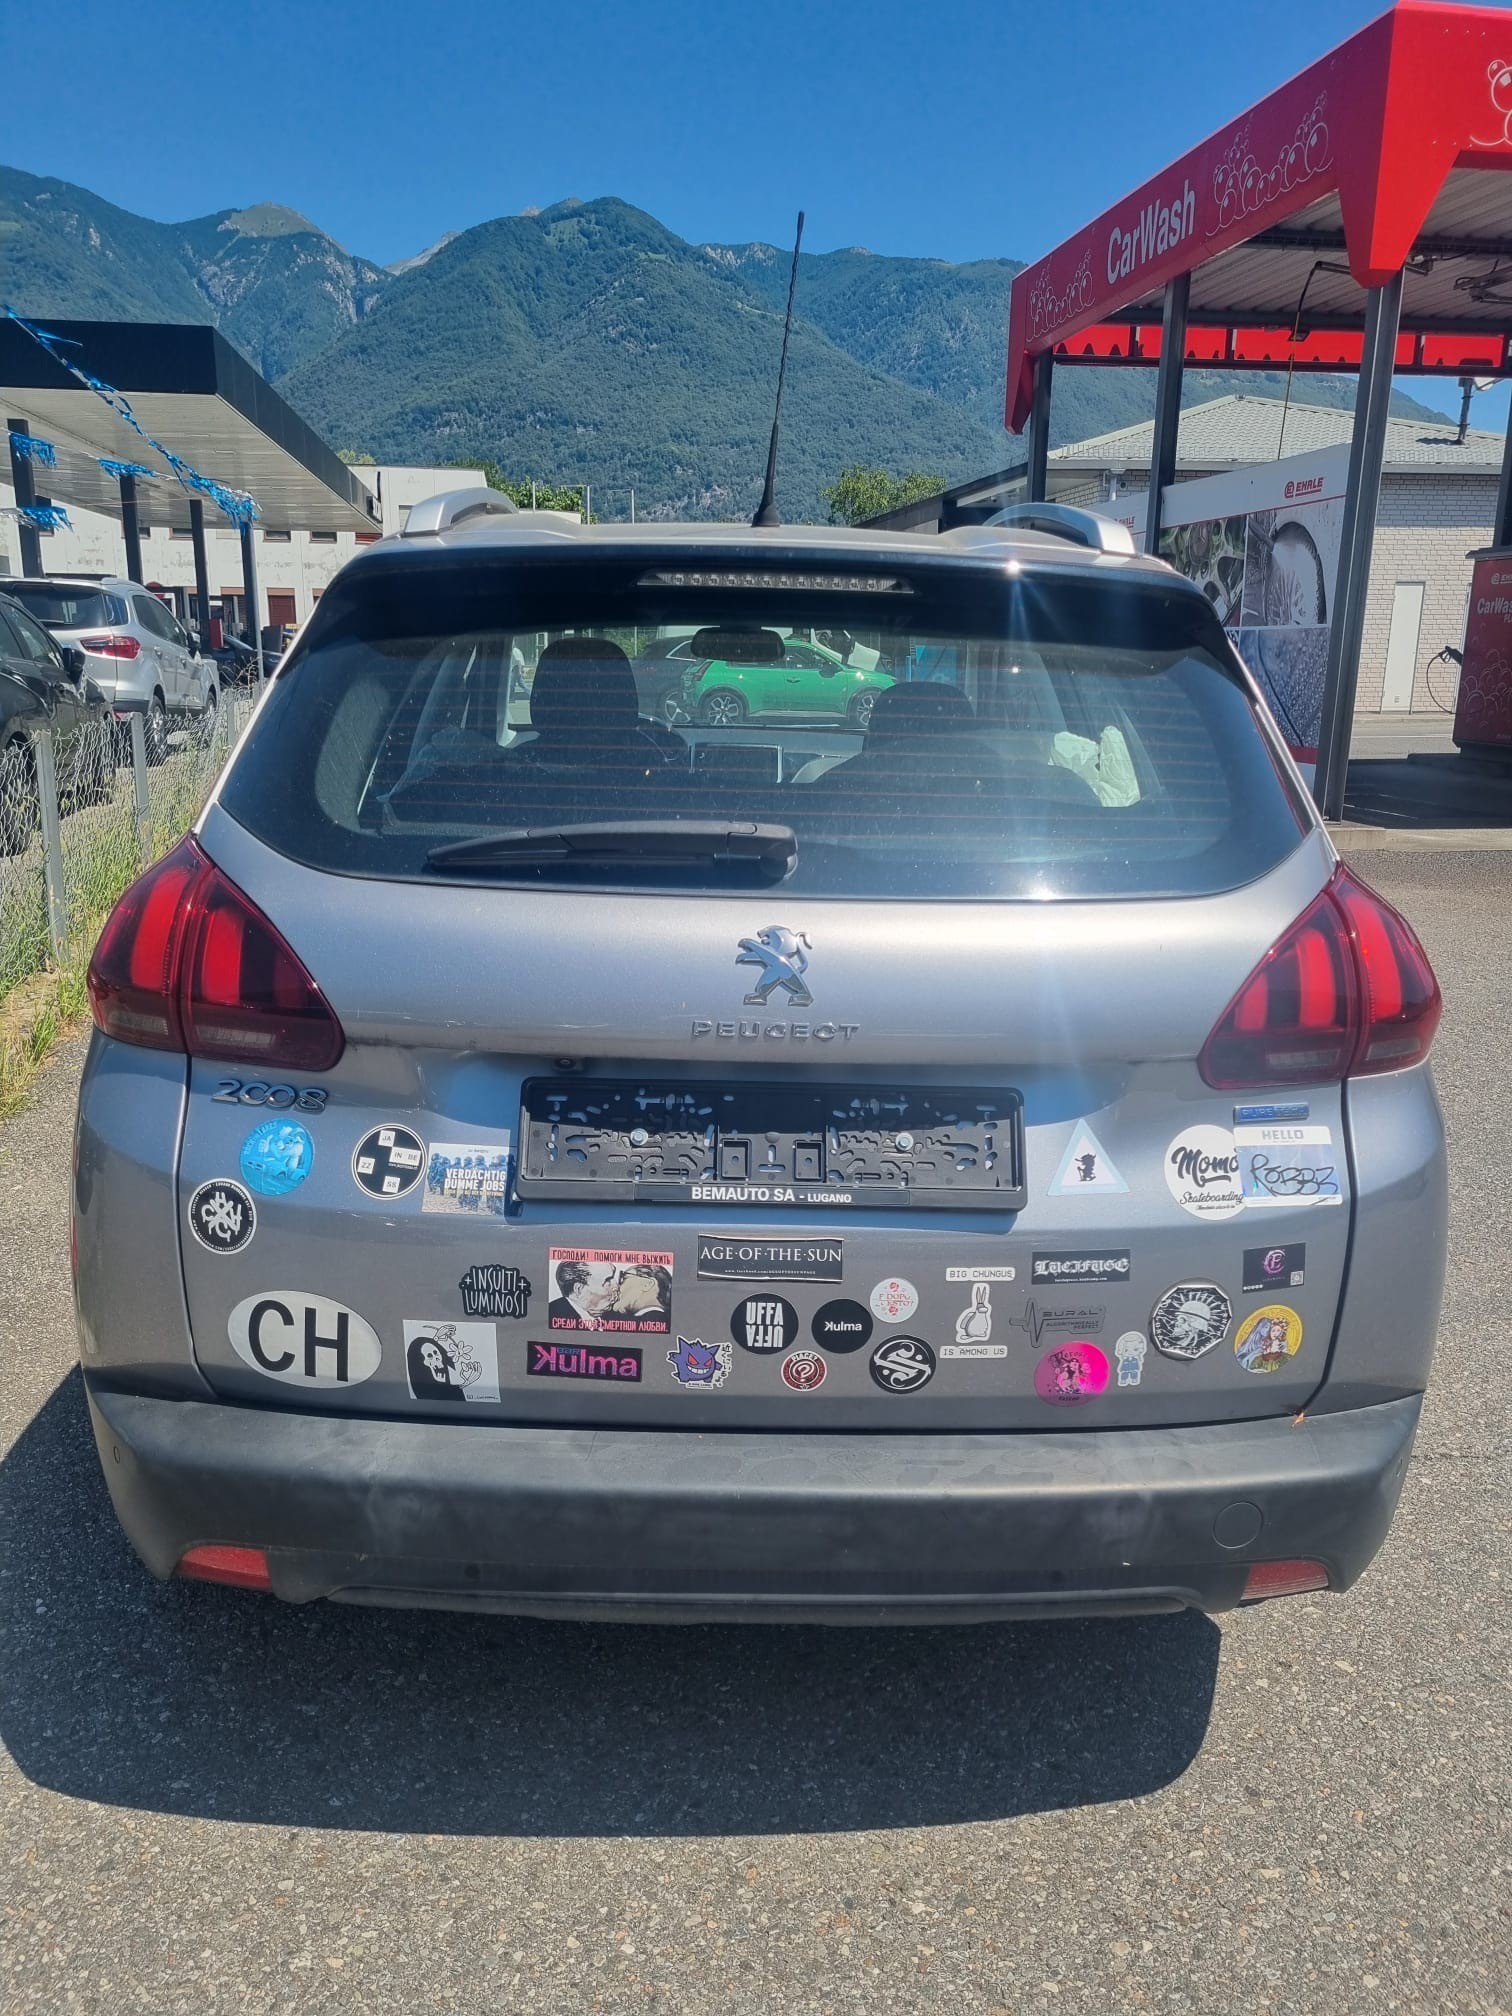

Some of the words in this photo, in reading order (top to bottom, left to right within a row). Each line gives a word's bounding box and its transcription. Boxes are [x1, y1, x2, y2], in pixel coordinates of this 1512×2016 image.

[1107, 179, 1195, 284] CarWash
[1295, 477, 1324, 492] EHRLE
[692, 1020, 860, 1039] PEUGEOT
[212, 1079, 328, 1114] 2008
[1262, 1129, 1304, 1140] HELLO
[444, 1178, 478, 1190] DUMME
[480, 1180, 505, 1191] JOBS
[691, 1187, 769, 1200] BEMAUTO
[773, 1188, 795, 1201] SA
[807, 1193, 852, 1203] LUGANO
[1180, 1191, 1245, 1206] Skateboarding
[552, 1250, 589, 1260] ГОСПОДИ!
[594, 1252, 622, 1262] ПОМОГИ
[625, 1254, 640, 1263] МНЕ
[642, 1254, 670, 1265] ВЫЖИТЬ
[472, 1267, 517, 1293] INSULTI
[949, 1270, 967, 1278] BIG
[973, 1270, 1012, 1278] CHUNGUS
[465, 1289, 524, 1316] LUMINOSI
[746, 1301, 784, 1324] UFFA
[552, 1317, 576, 1328] СРЕДИ
[248, 1299, 349, 1382] CH
[943, 1348, 954, 1356] IS
[959, 1348, 988, 1356] AMONG
[993, 1347, 1005, 1355] US
